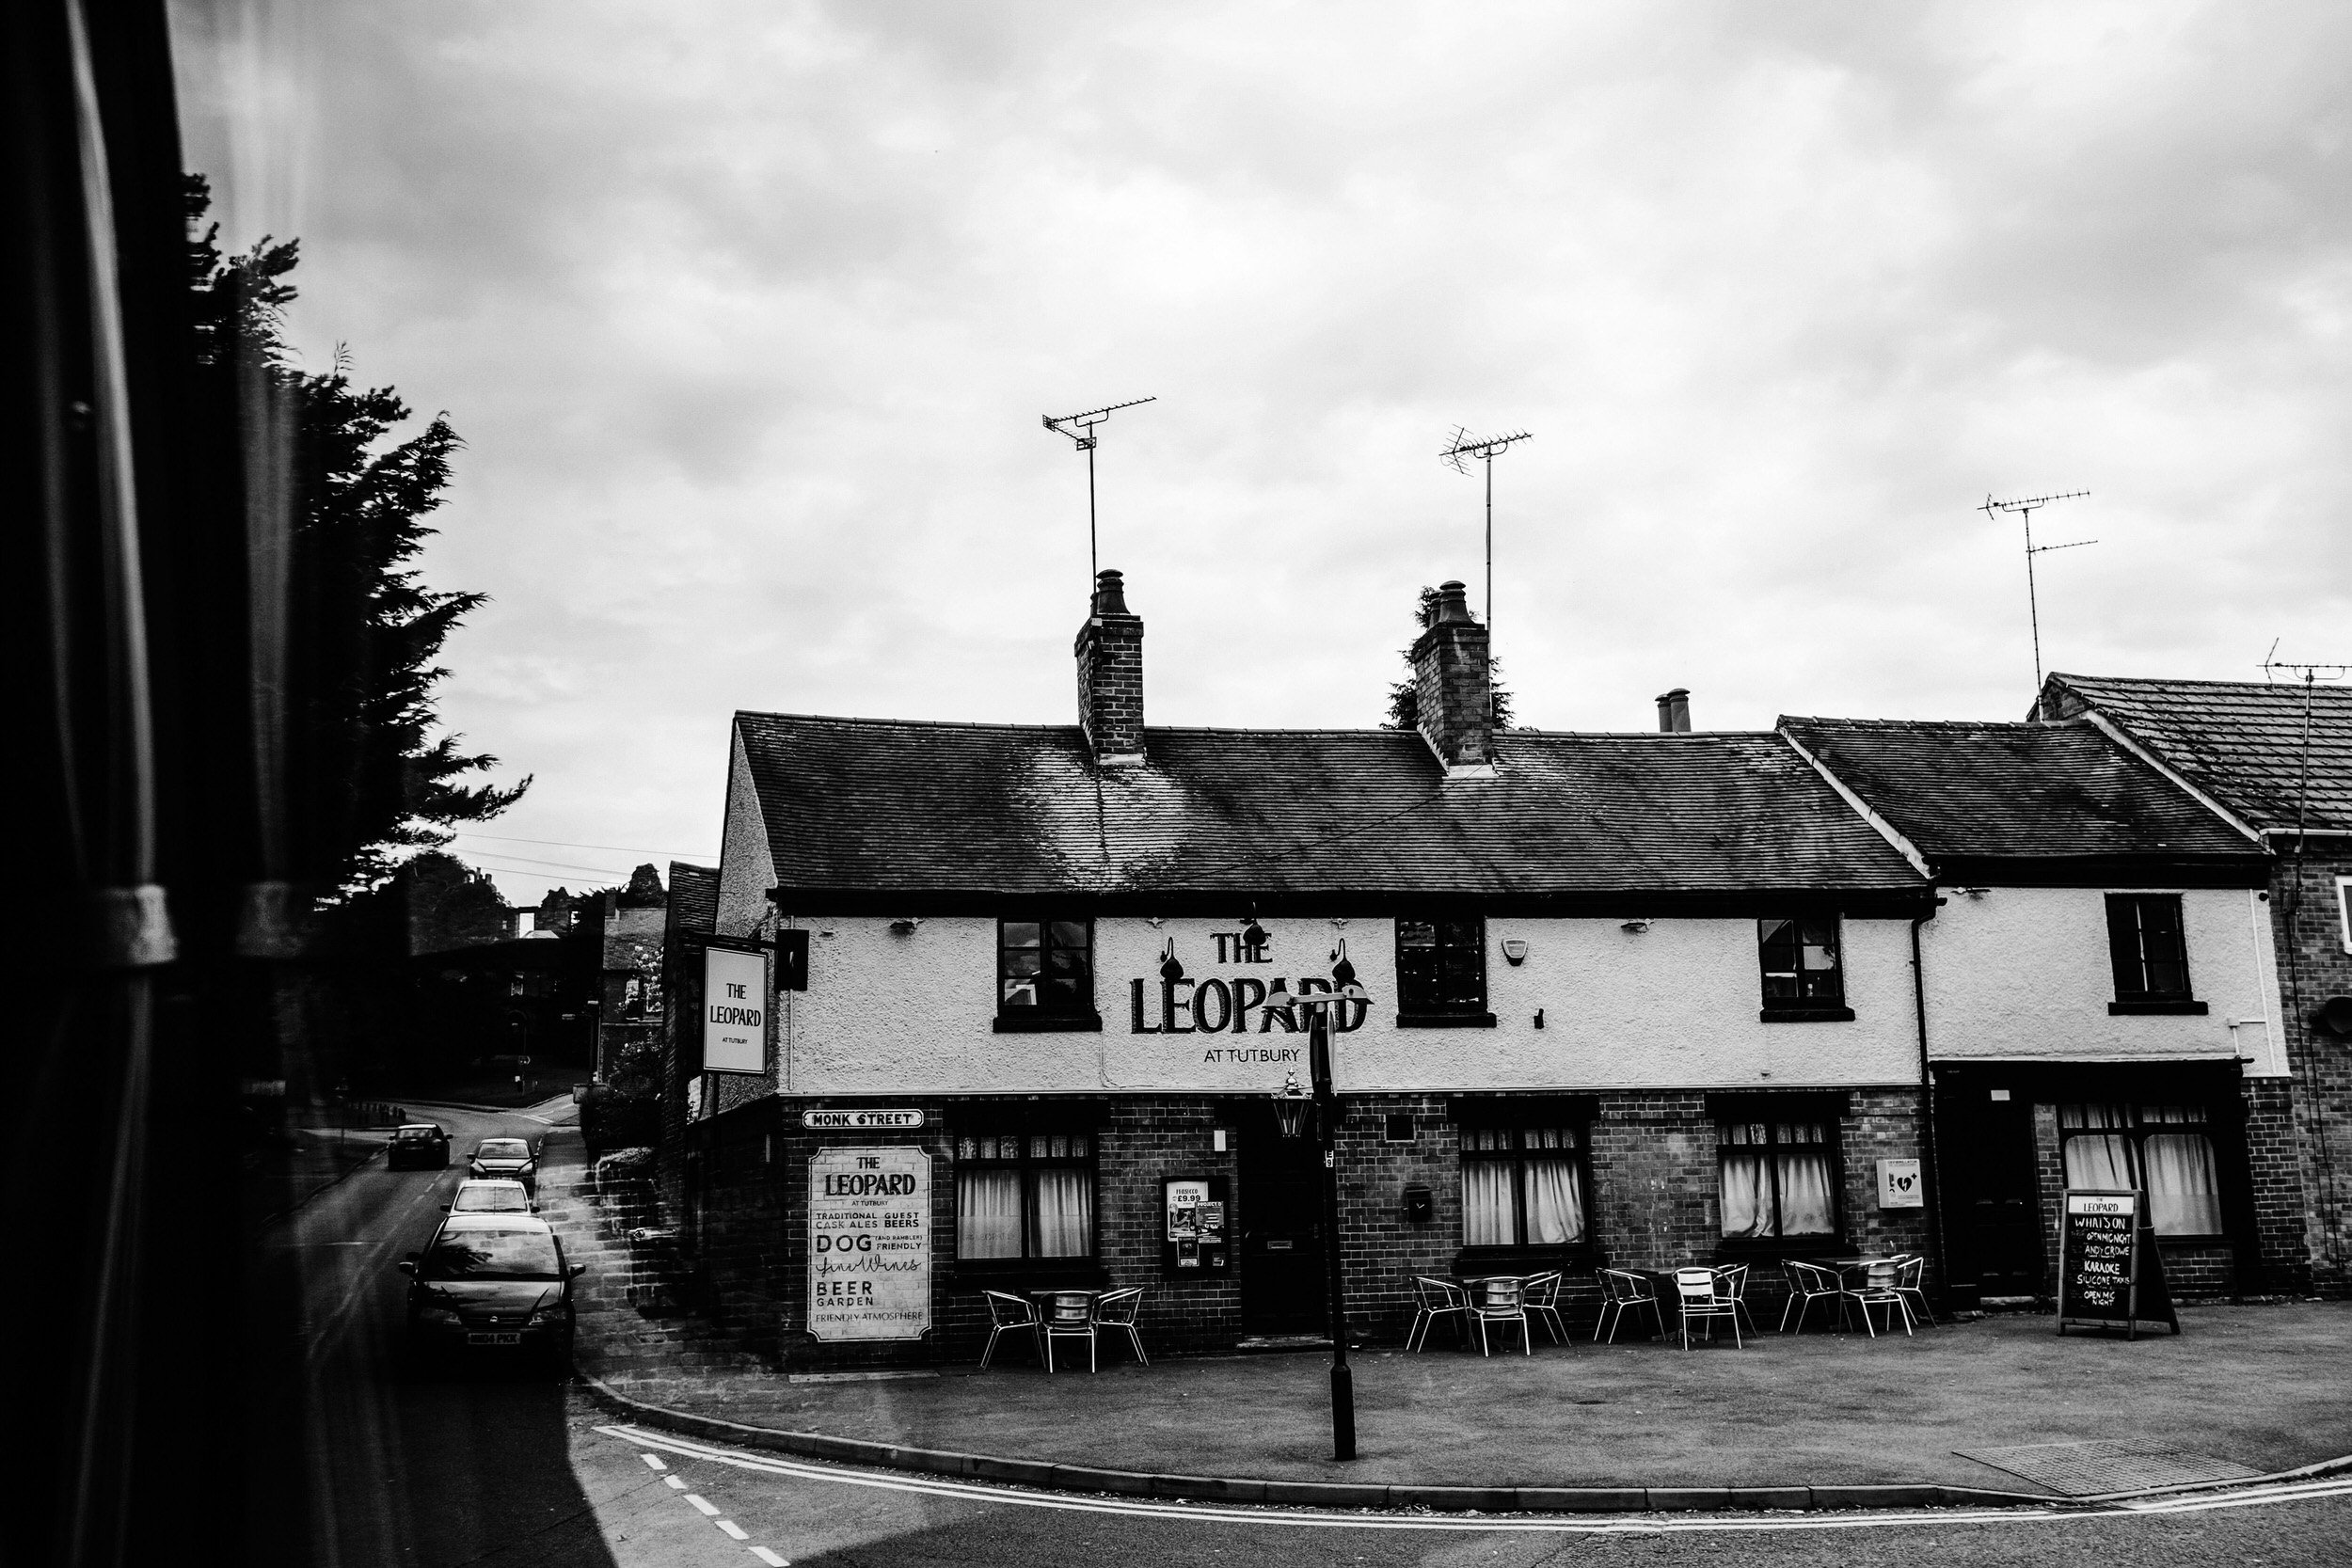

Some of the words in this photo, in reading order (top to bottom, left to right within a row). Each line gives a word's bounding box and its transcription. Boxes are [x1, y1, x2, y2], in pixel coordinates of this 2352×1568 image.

[1210, 932, 1272, 963] THE
[726, 982, 747, 1000] THE
[710, 1005, 761, 1027] LEOPARD
[1204, 1050, 1224, 1062] AT
[1227, 1049, 1299, 1063] TUTBURY
[813, 1114, 850, 1126] MONK
[857, 1114, 912, 1125] STREET
[856, 1156, 881, 1169] THE
[825, 1173, 916, 1196] LEOPARD
[2083, 1203, 2119, 1212] LEOPARD
[816, 1221, 845, 1229] CASK
[850, 1220, 878, 1228] ALES
[884, 1219, 919, 1228] BEERS
[2112, 1217, 2126, 1230] ON
[817, 1234, 872, 1253] DOG
[2084, 1260, 2121, 1275] KARAOKE
[817, 1280, 873, 1296] BEER
[817, 1296, 874, 1307] GARDEN
[2083, 1291, 2102, 1299] OPEN
[816, 1313, 860, 1323] FRIENDLY
[862, 1311, 923, 1321] ATMOSPHERE
